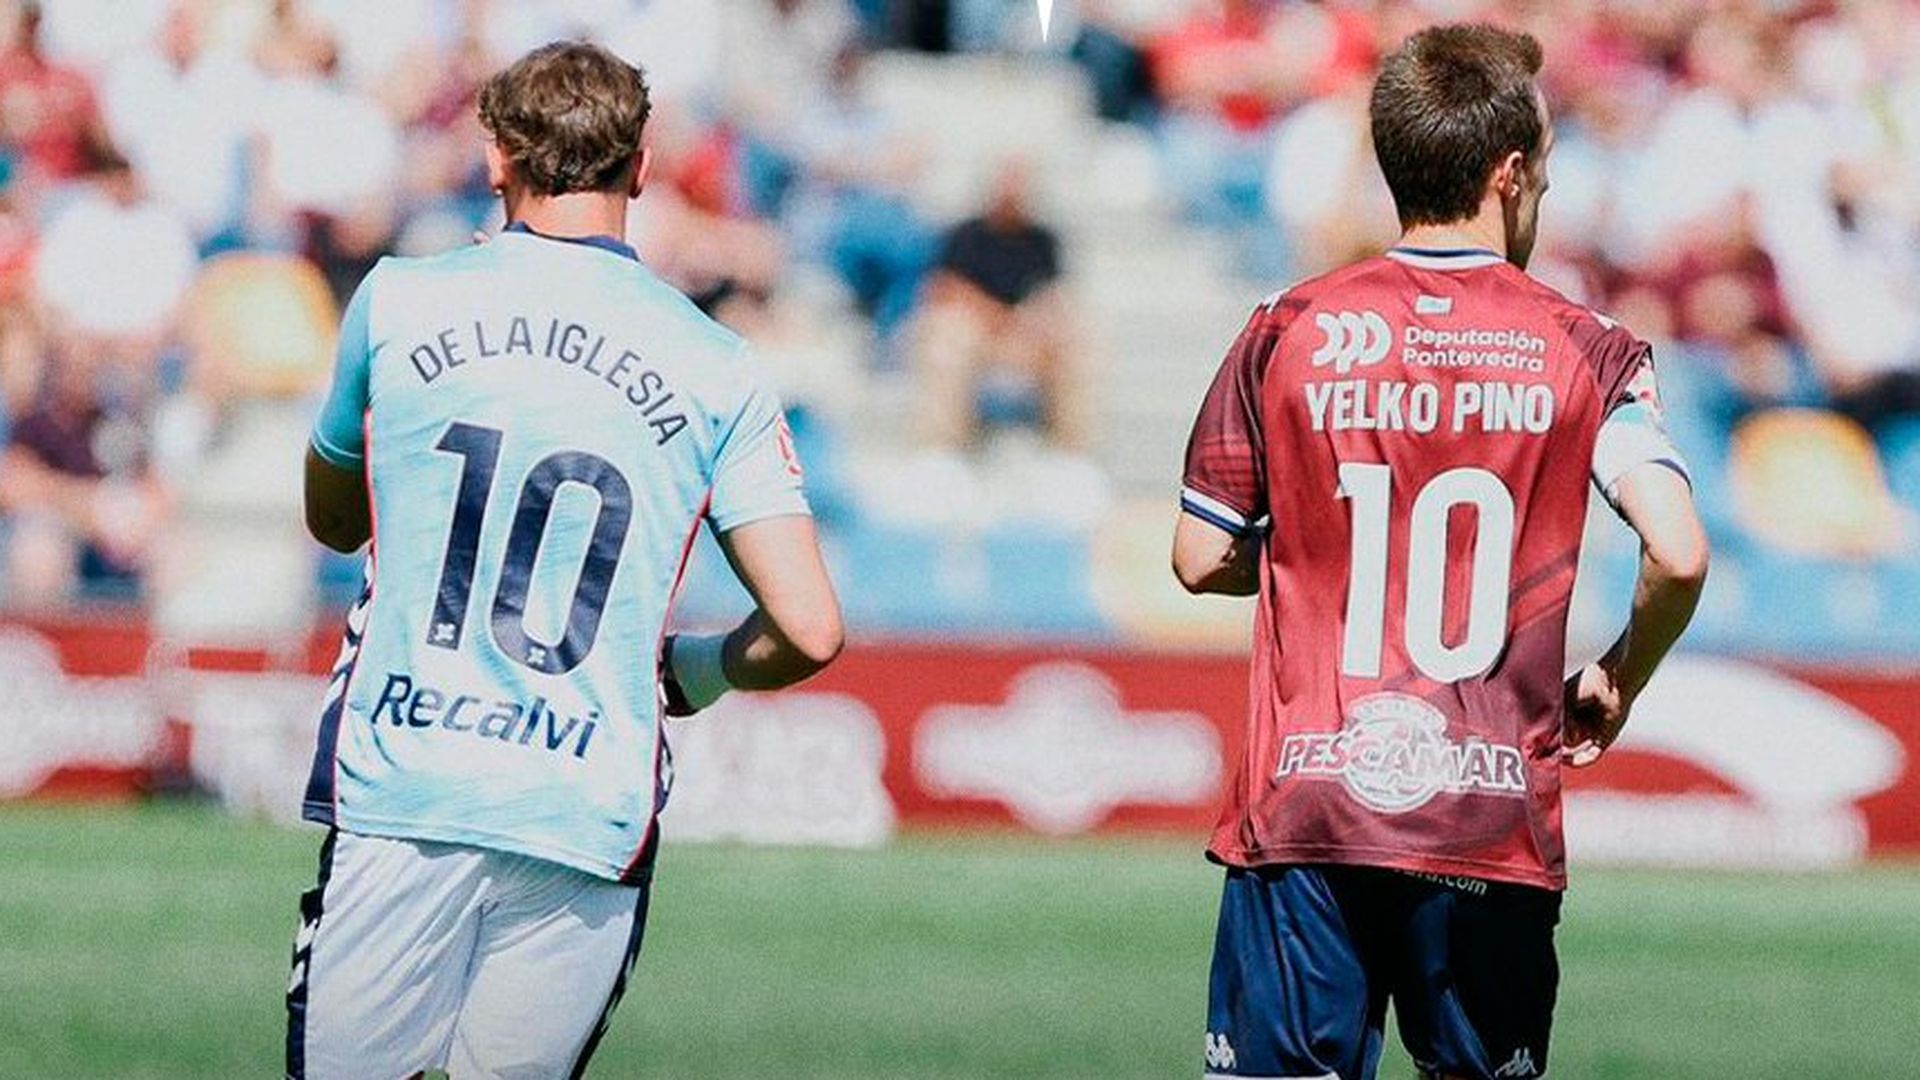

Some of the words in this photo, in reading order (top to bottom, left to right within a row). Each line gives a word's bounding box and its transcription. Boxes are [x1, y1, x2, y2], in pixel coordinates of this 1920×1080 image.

[1403, 347, 1545, 372] Pontevedra
[1405, 326, 1546, 352] Deputación
[410, 328, 466, 384] DE
[475, 317, 534, 358] LA
[545, 319, 688, 447] IGLESIA
[1304, 379, 1440, 433] YELKO
[1452, 381, 1554, 433] PINO
[426, 421, 632, 675] 10
[1334, 462, 1515, 684] 10
[371, 673, 600, 758] Recalvi
[1279, 735, 1524, 788] PESCAMAR
